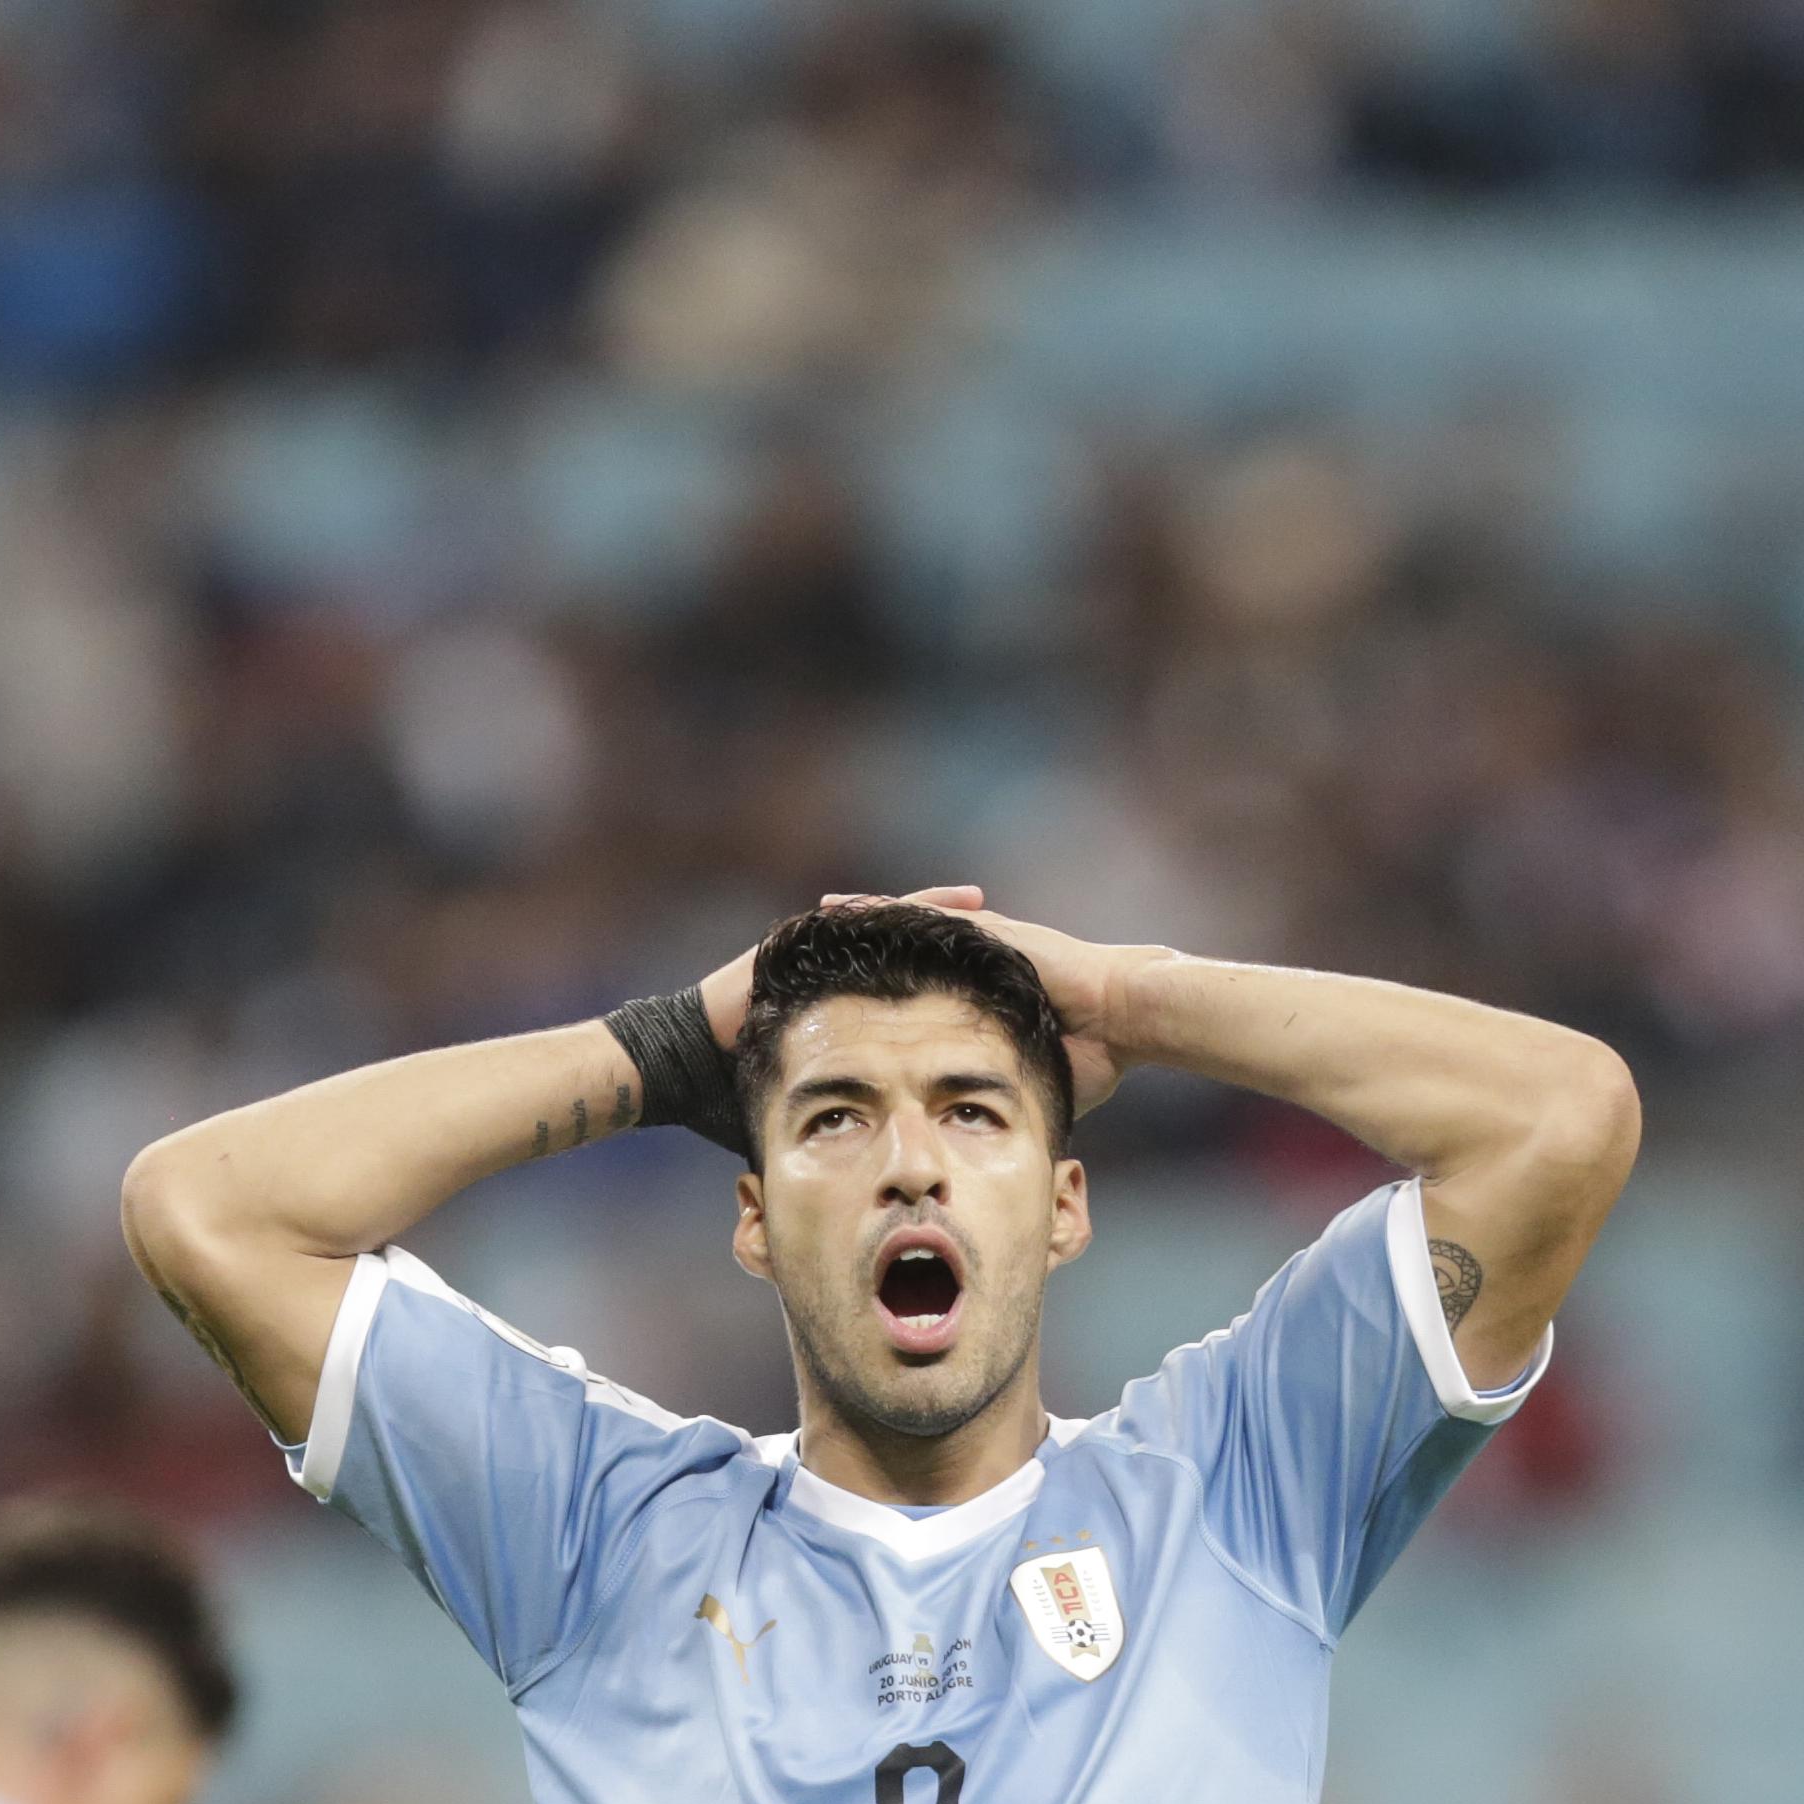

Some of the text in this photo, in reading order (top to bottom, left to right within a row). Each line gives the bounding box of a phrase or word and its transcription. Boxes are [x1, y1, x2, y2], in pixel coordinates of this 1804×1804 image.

[1053, 1572, 1083, 1615] AUF
[868, 1653, 913, 1675] URUGUAY
[877, 1676, 974, 1706] PORTO ALEGRE
[880, 1675, 894, 1689] 20
[898, 1674, 939, 1688] JUNIO
